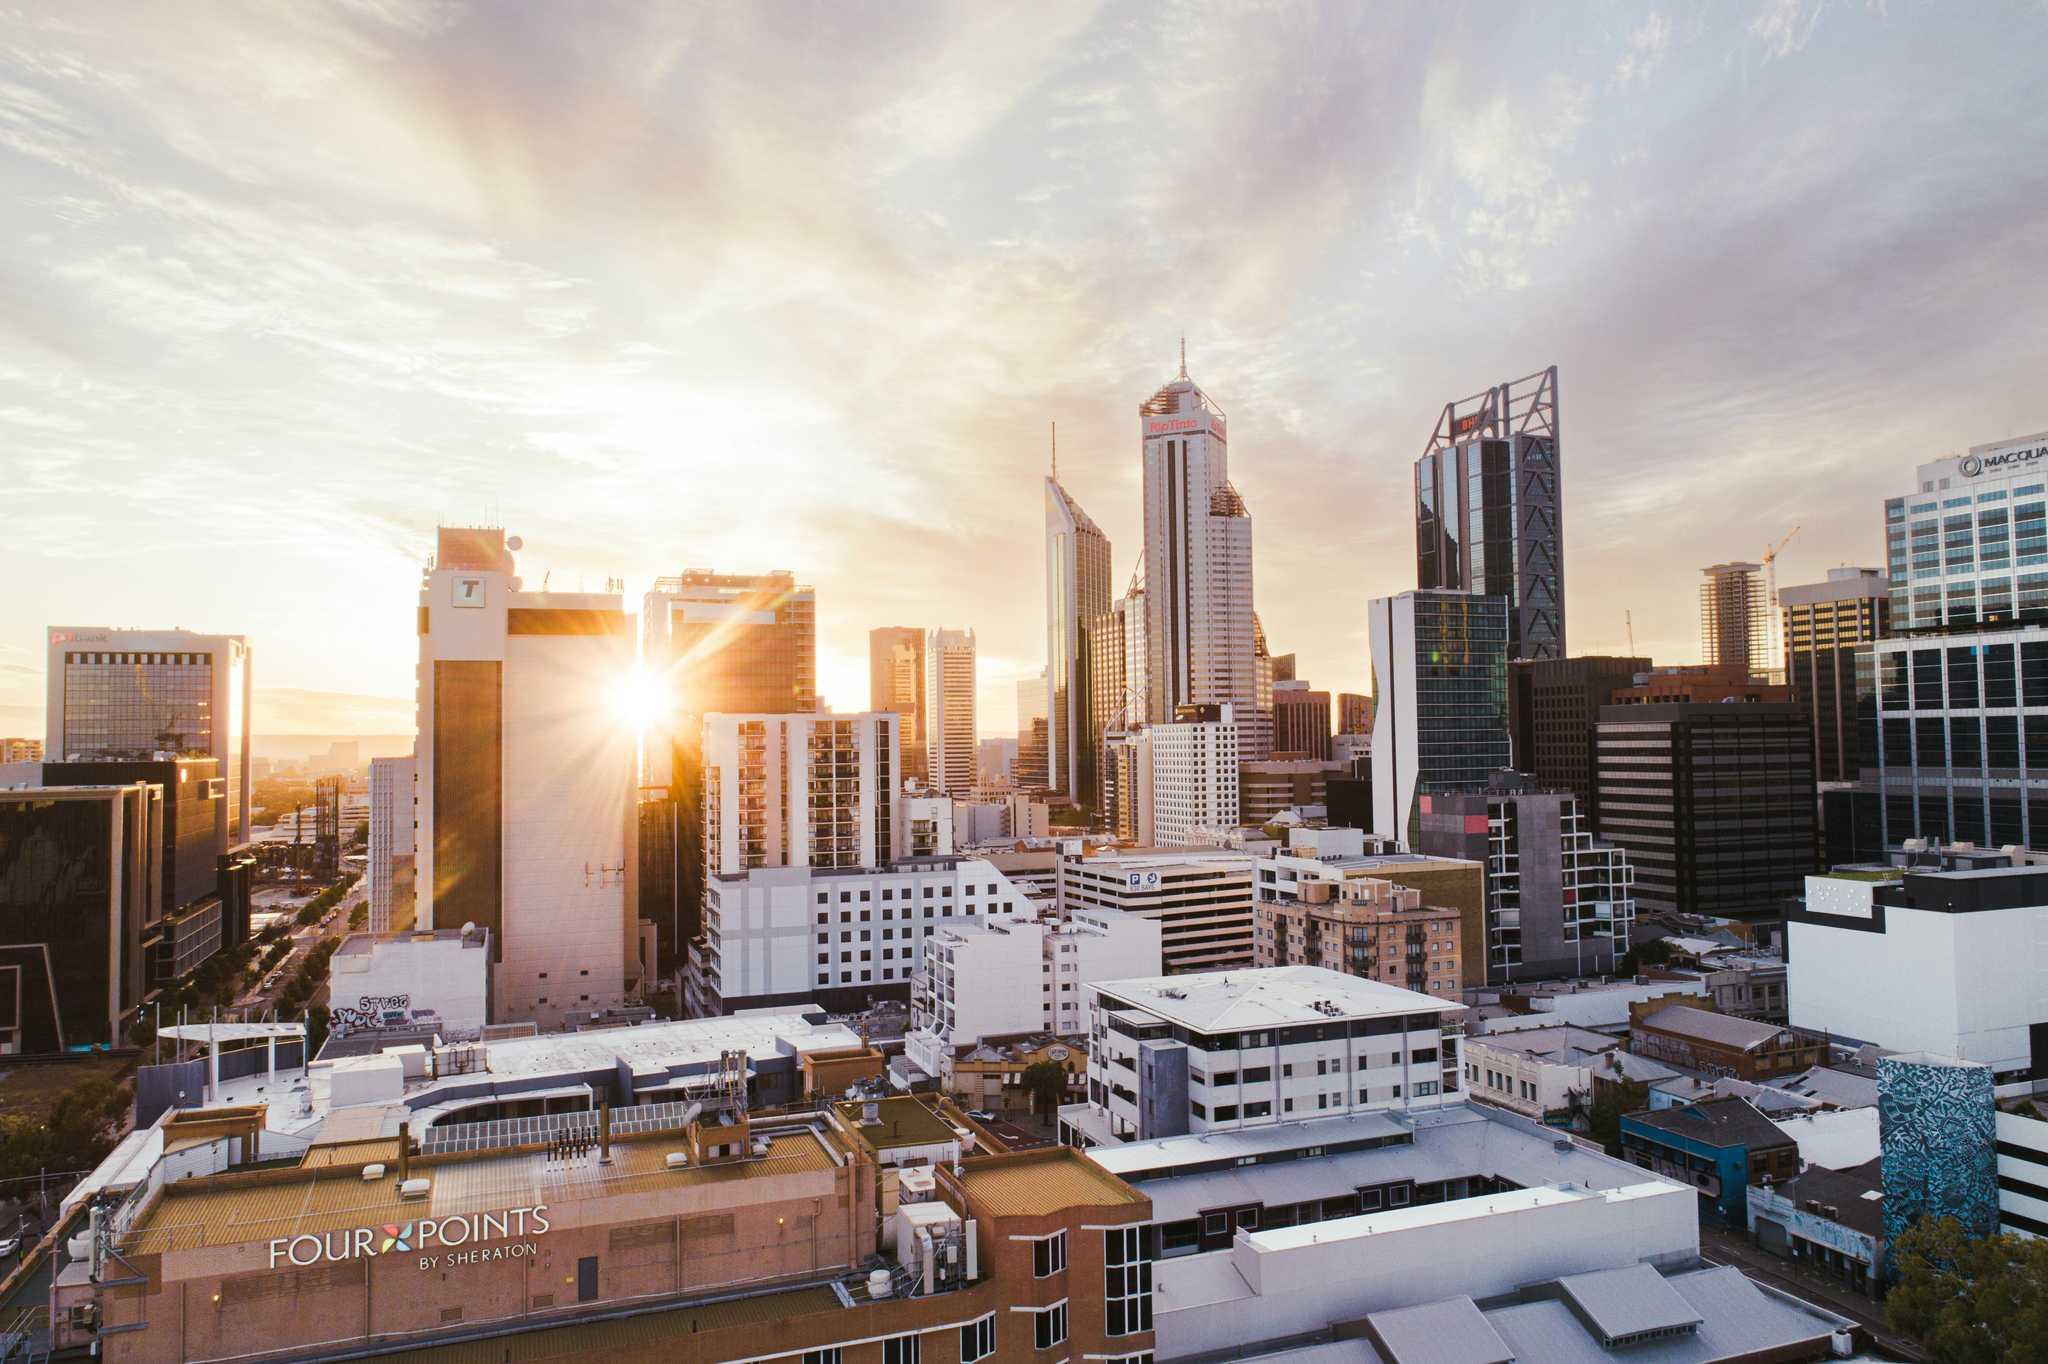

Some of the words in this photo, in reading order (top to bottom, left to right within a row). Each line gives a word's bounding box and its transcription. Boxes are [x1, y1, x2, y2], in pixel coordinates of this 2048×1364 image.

[462, 580, 480, 598] T
[269, 1228, 378, 1269] FOUR
[419, 1205, 550, 1249] POINTS
[419, 1256, 440, 1270] BY
[447, 1242, 538, 1267] SHERATON
